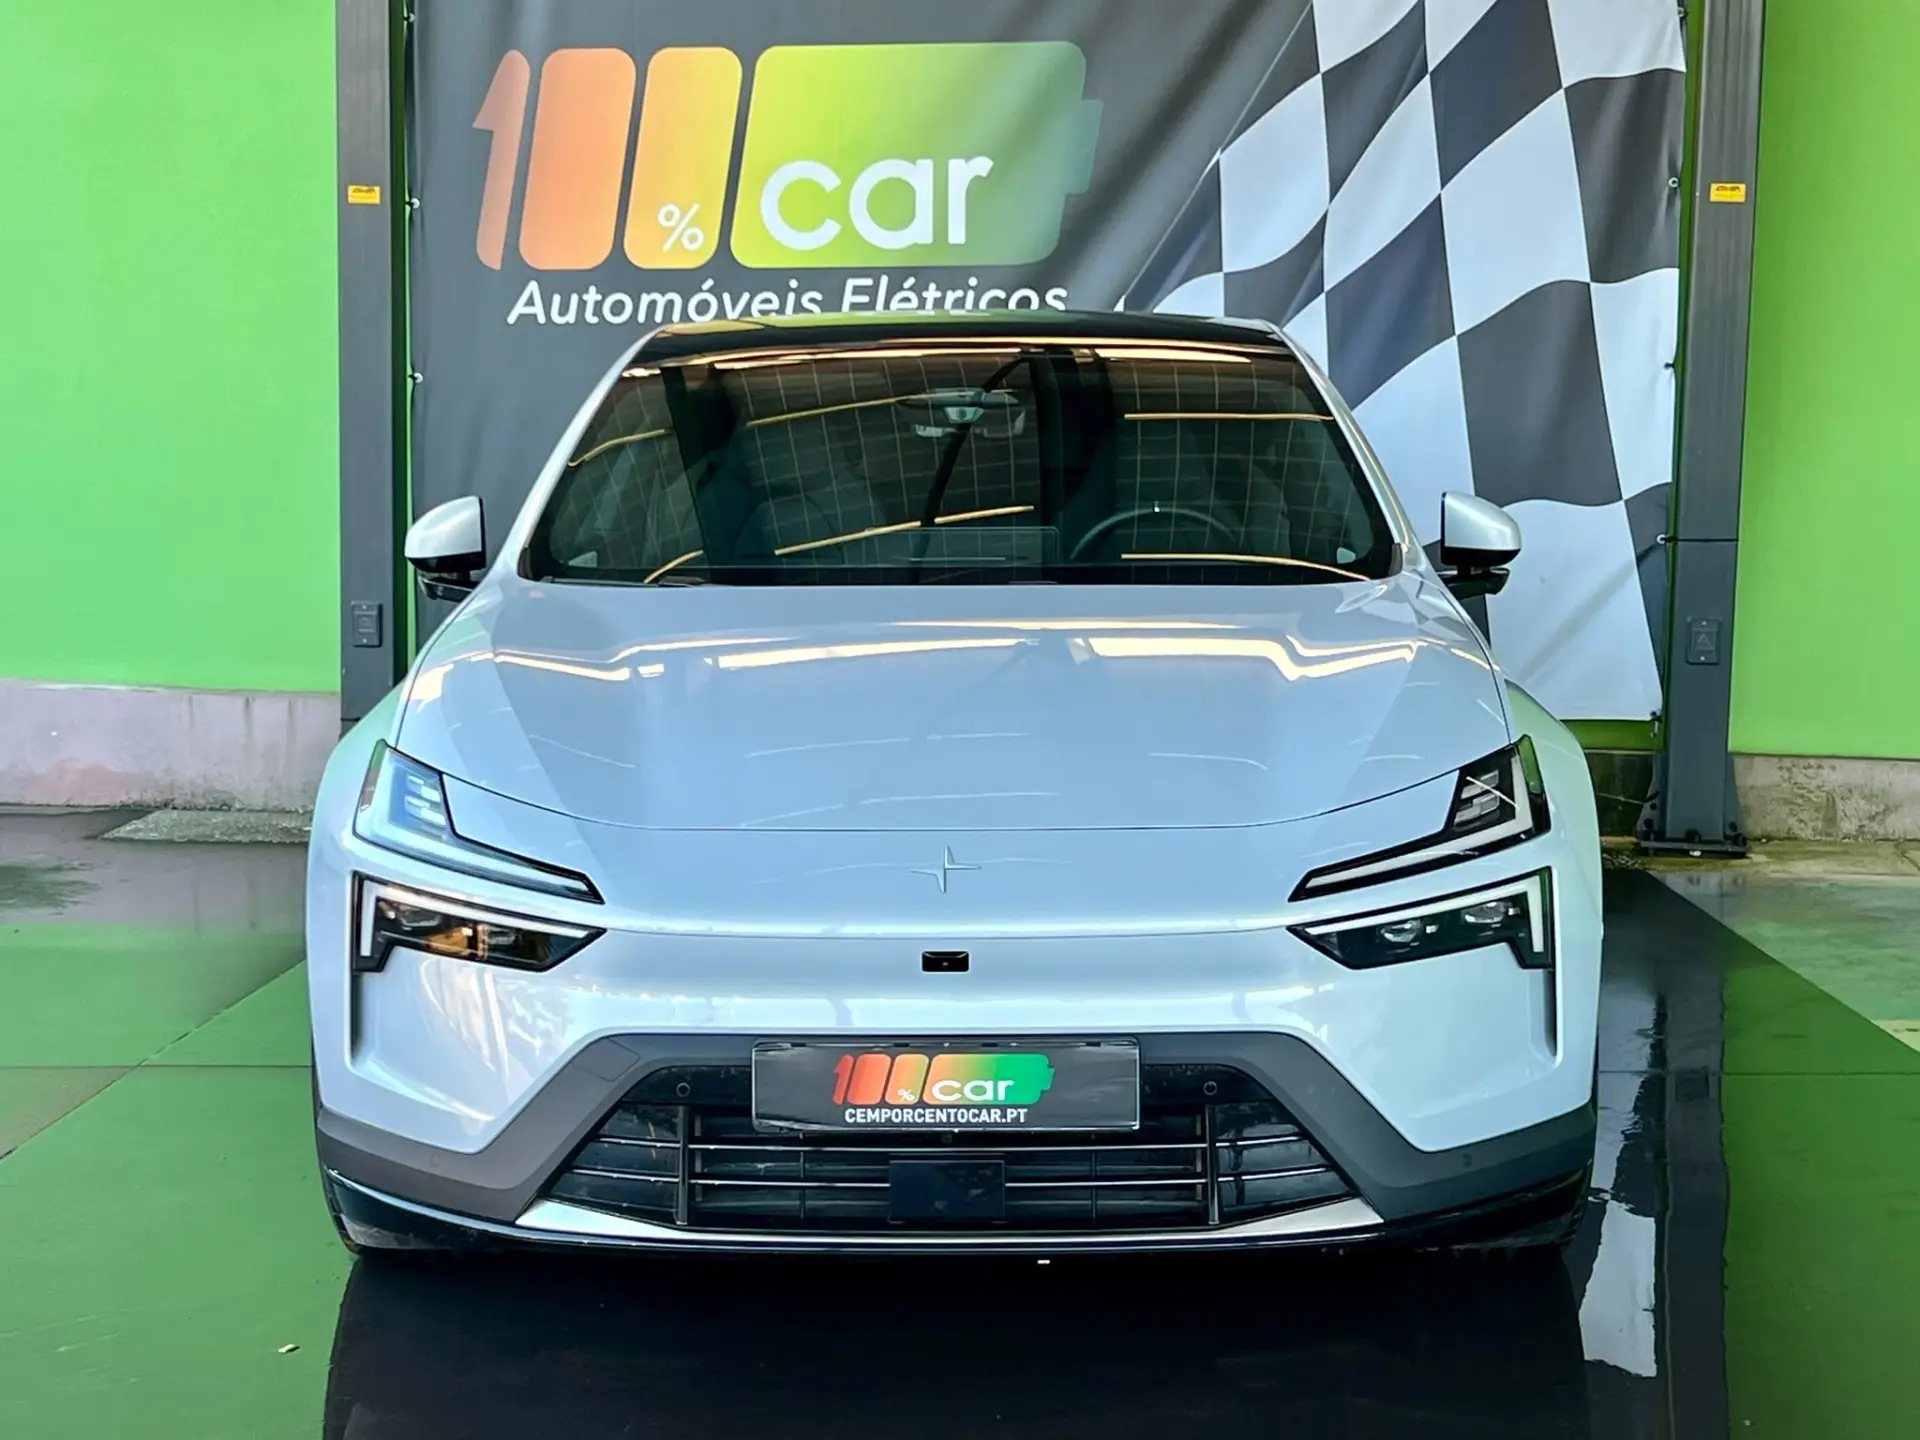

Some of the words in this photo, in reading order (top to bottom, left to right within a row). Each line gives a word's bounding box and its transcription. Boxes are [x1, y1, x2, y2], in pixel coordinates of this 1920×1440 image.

[760, 155, 994, 250] car
[507, 278, 824, 325] Automóveis
[841, 274, 1068, 312] Elétricos
[931, 1079, 1015, 1102] car
[844, 1107, 1028, 1124] CEMPORCENTOCAR.PT
